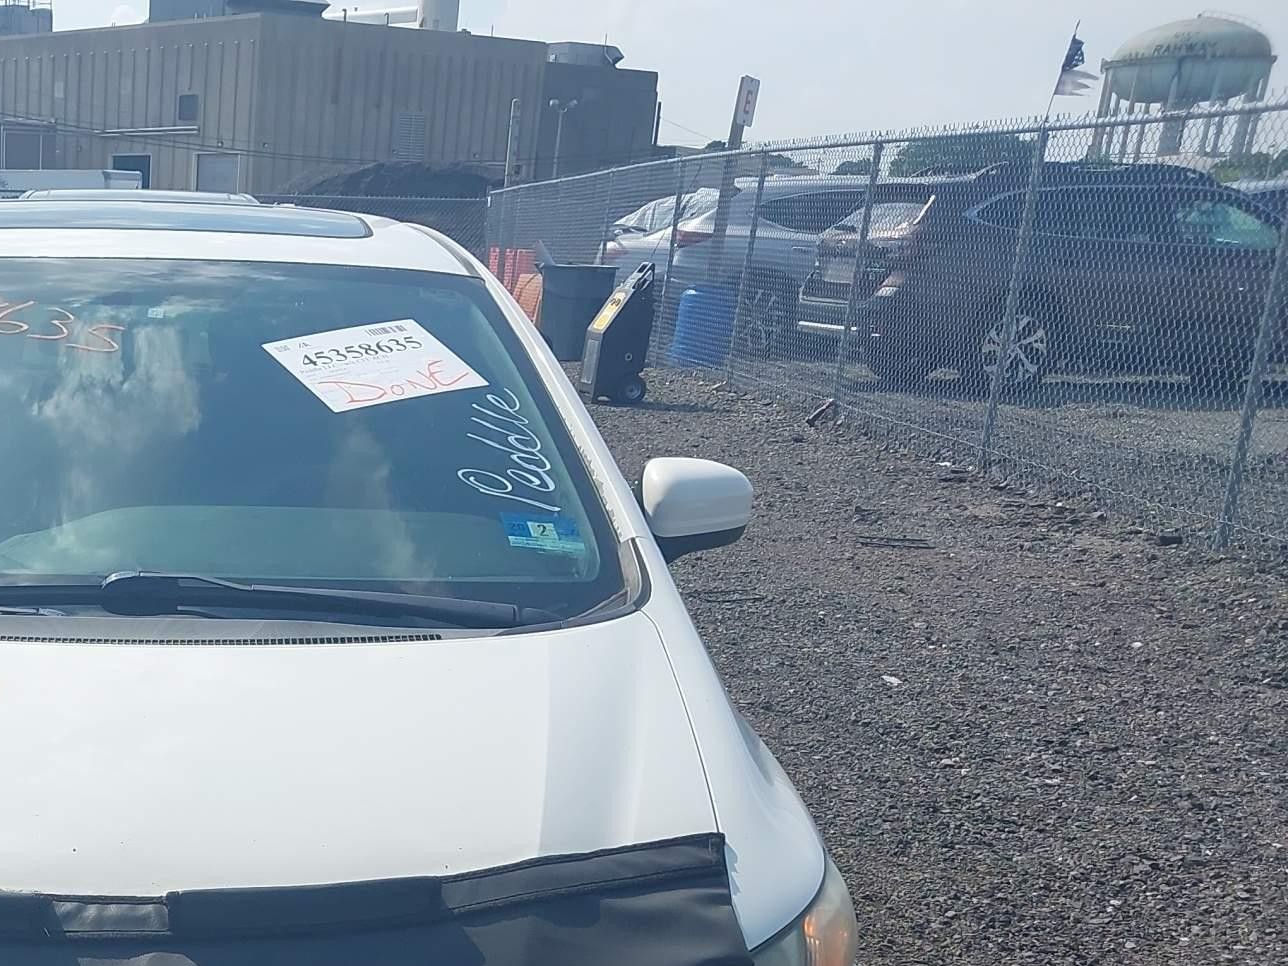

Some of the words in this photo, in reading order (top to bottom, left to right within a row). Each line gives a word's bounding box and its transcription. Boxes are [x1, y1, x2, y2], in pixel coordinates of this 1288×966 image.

[1152, 41, 1218, 56] RAHWAY
[302, 335, 423, 367] 45358635
[536, 524, 550, 537] 2
